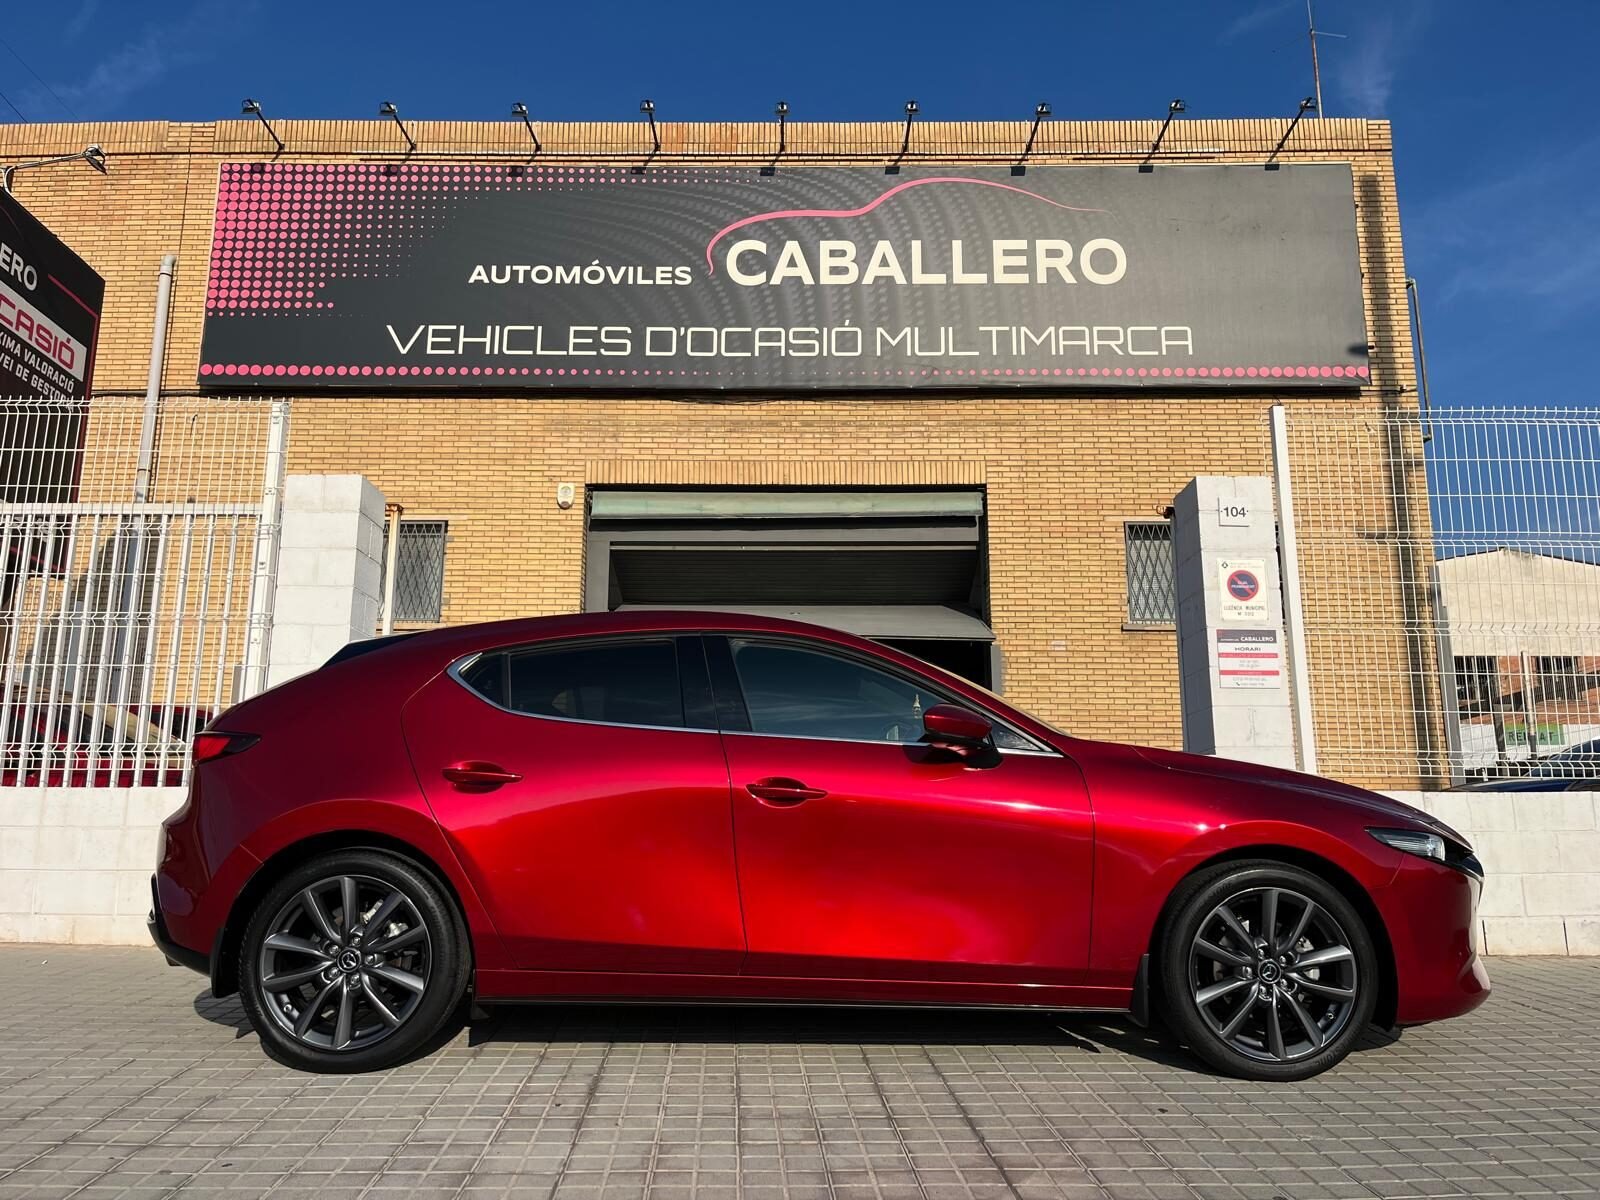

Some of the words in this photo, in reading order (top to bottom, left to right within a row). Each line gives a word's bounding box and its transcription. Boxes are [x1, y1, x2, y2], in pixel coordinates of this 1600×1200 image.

[468, 260, 692, 286] AUTOMÓVILES
[726, 238, 1127, 286] CABALLERO
[386, 324, 632, 356] VEHICLES
[645, 319, 862, 357] D'OCASIÓ
[876, 325, 1194, 357] MULTIMARCA
[15, 363, 30, 382] DE
[24, 348, 75, 393] VALORACIÓ
[1223, 506, 1247, 517] 104
